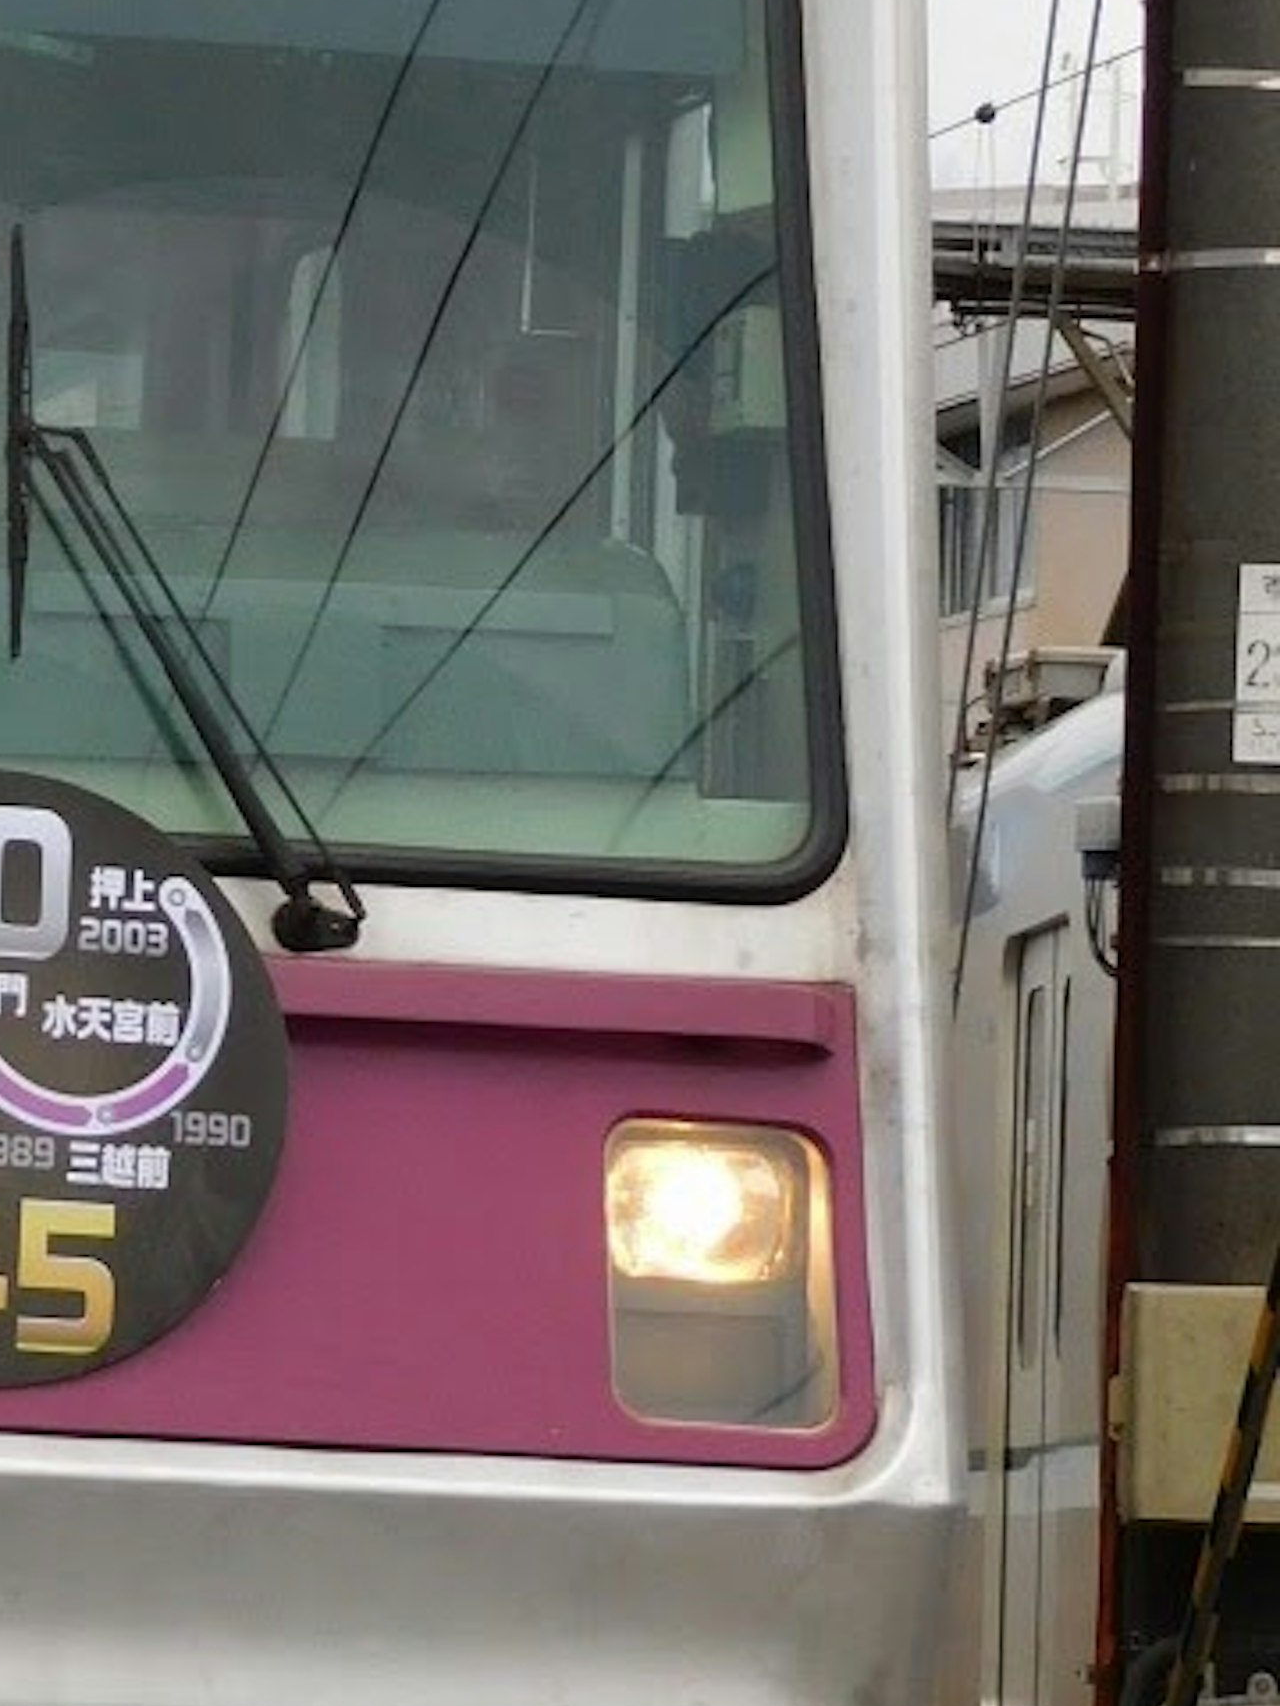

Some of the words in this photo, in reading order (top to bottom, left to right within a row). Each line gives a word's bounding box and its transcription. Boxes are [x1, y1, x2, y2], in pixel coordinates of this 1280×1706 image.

[88, 866, 156, 912] 押上
[78, 919, 169, 955] 2003
[41, 996, 181, 1047] 水天宮前
[170, 1110, 251, 1147] 1990
[65, 1142, 172, 1190] 三越前
